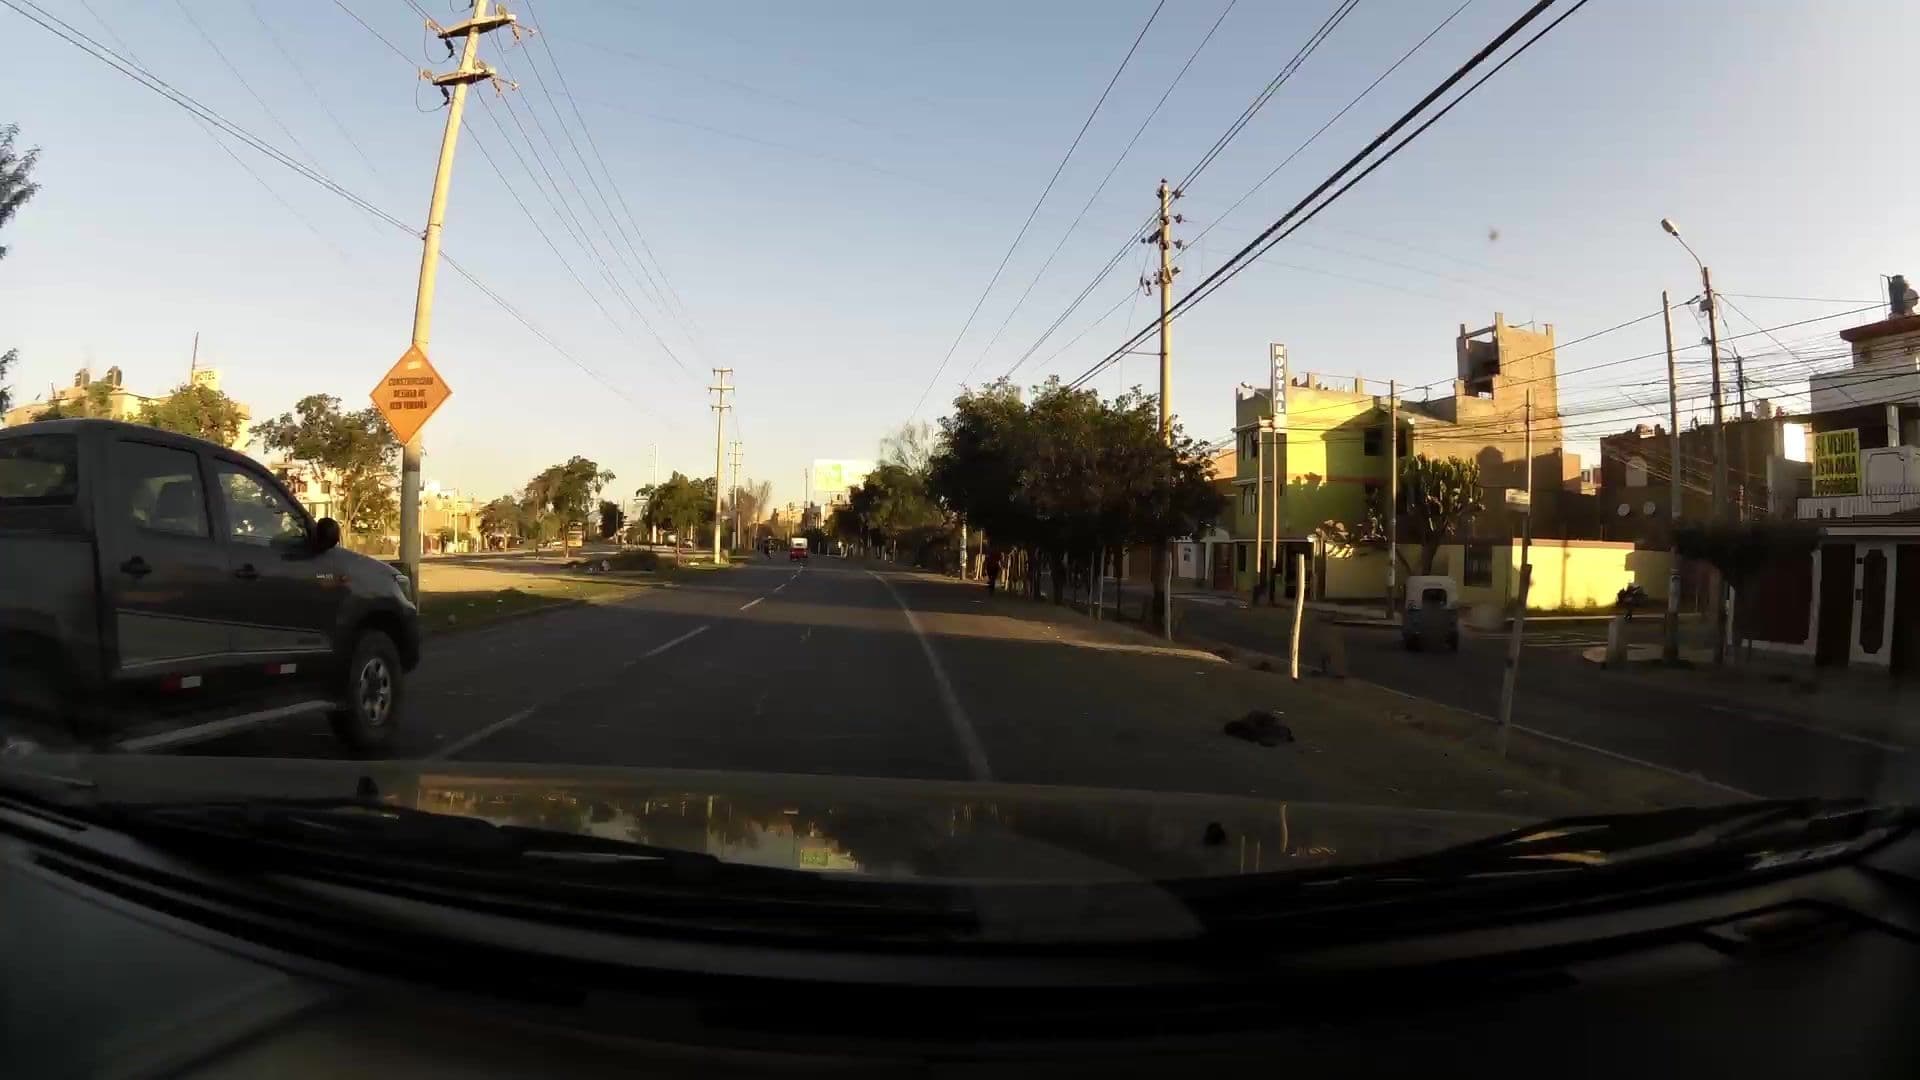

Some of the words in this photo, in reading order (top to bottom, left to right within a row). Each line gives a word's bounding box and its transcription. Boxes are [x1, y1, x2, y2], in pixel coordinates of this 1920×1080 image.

[1275, 345, 1285, 413] HOSTAL
[1816, 435, 1824, 456] SE
[1827, 431, 1856, 454] VENDE
[1835, 456, 1857, 474] CASA
